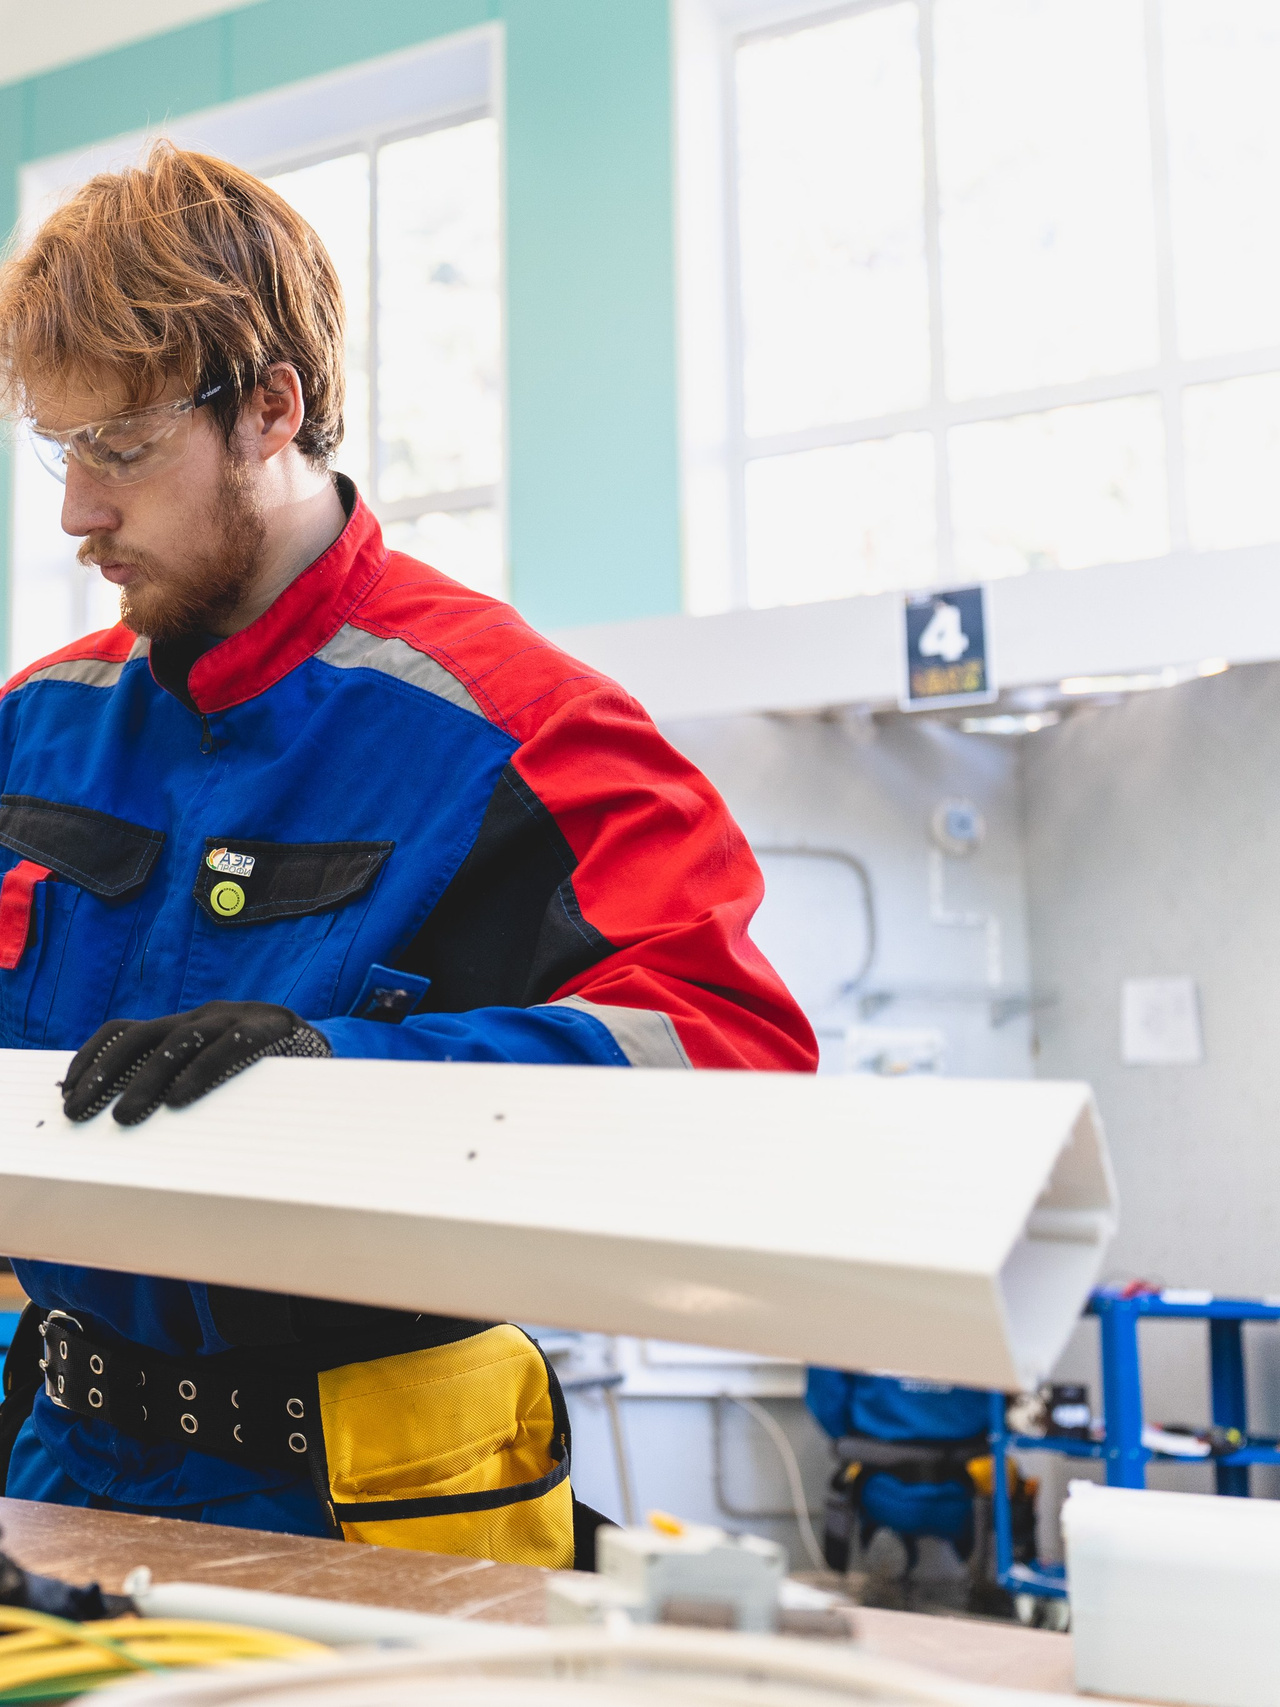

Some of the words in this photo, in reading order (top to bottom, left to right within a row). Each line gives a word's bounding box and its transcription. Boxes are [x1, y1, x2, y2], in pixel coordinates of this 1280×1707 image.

[919, 604, 969, 662] 4
[219, 852, 254, 868] АЭР
[217, 863, 252, 876] ПРОФИ
